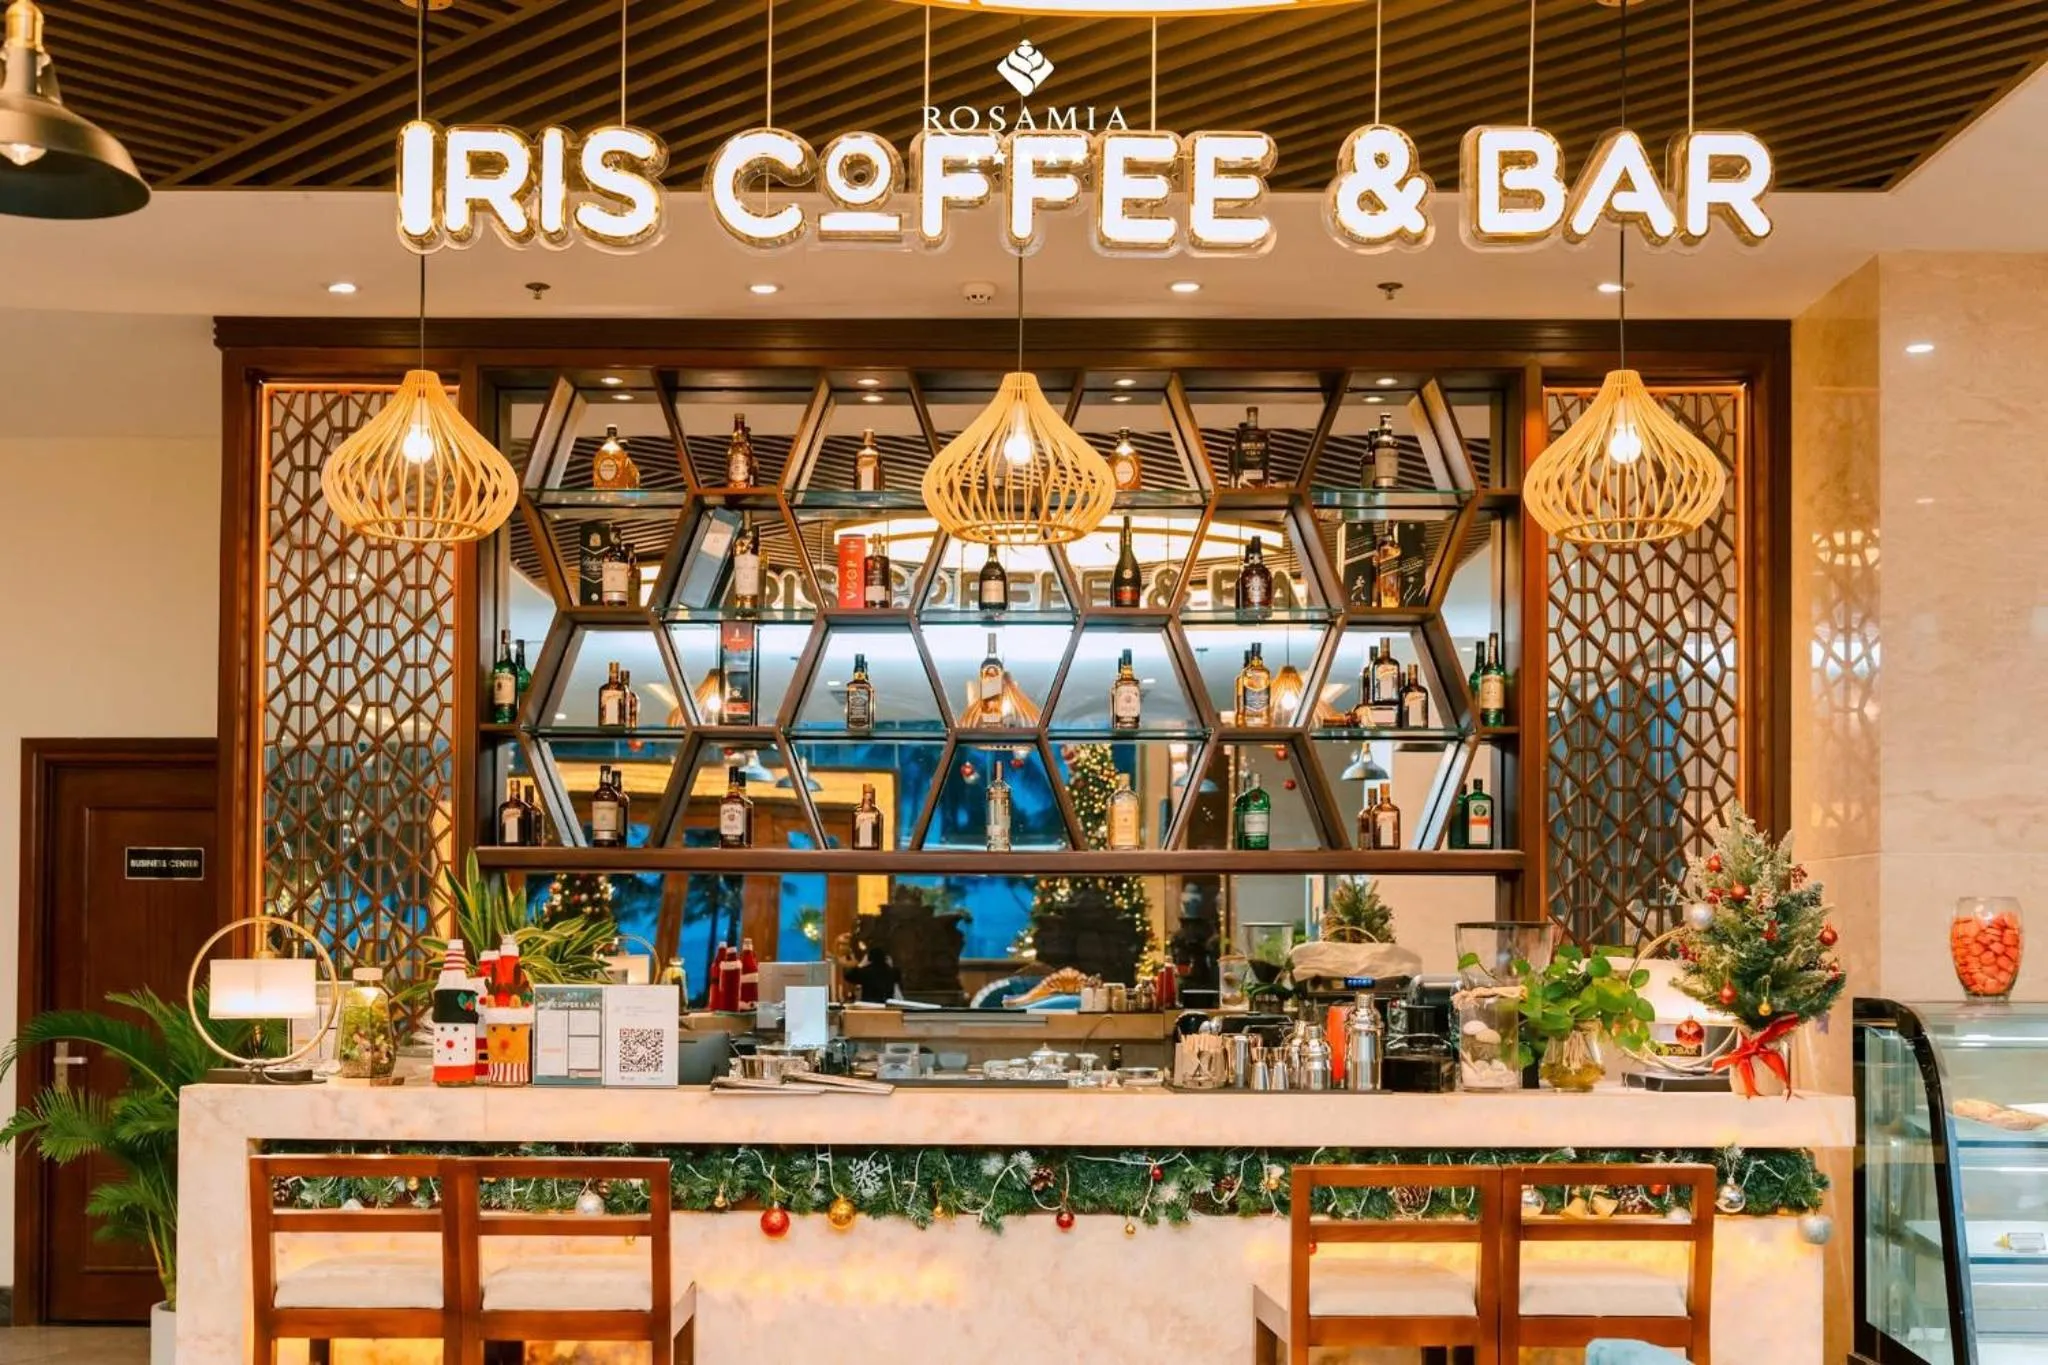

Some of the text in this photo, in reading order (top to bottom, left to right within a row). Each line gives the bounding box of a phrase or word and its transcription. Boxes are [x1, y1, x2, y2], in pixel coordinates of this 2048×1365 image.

[399, 119, 1774, 246] IRIS COFFEE & BAR
